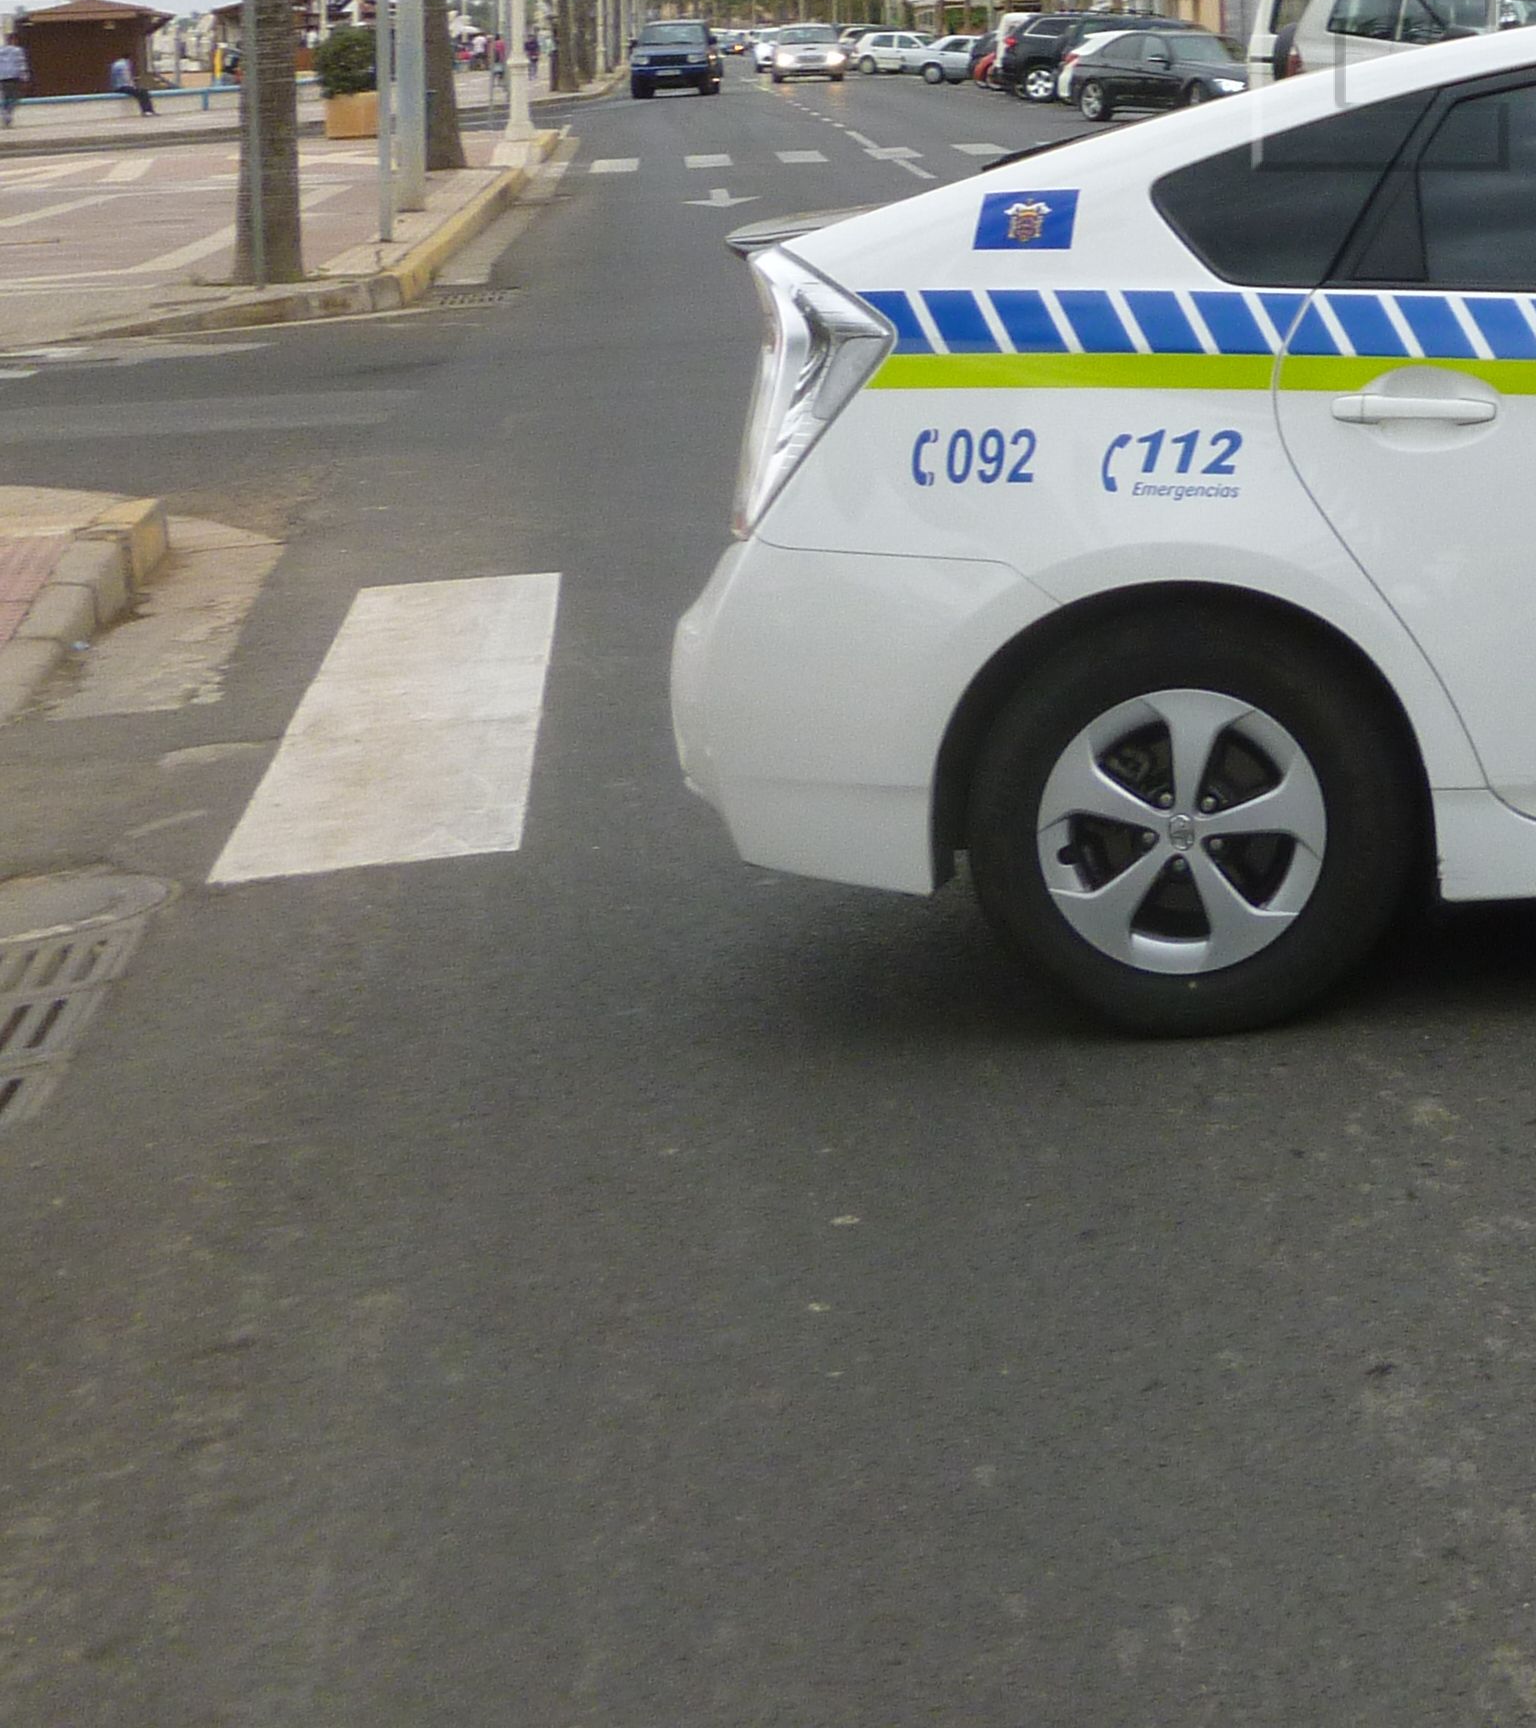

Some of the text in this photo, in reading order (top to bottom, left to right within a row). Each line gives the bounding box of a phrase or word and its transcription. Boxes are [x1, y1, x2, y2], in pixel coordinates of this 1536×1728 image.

[946, 428, 1037, 484] 092
[1137, 429, 1243, 475] 112
[1132, 481, 1241, 502] Emergencias
